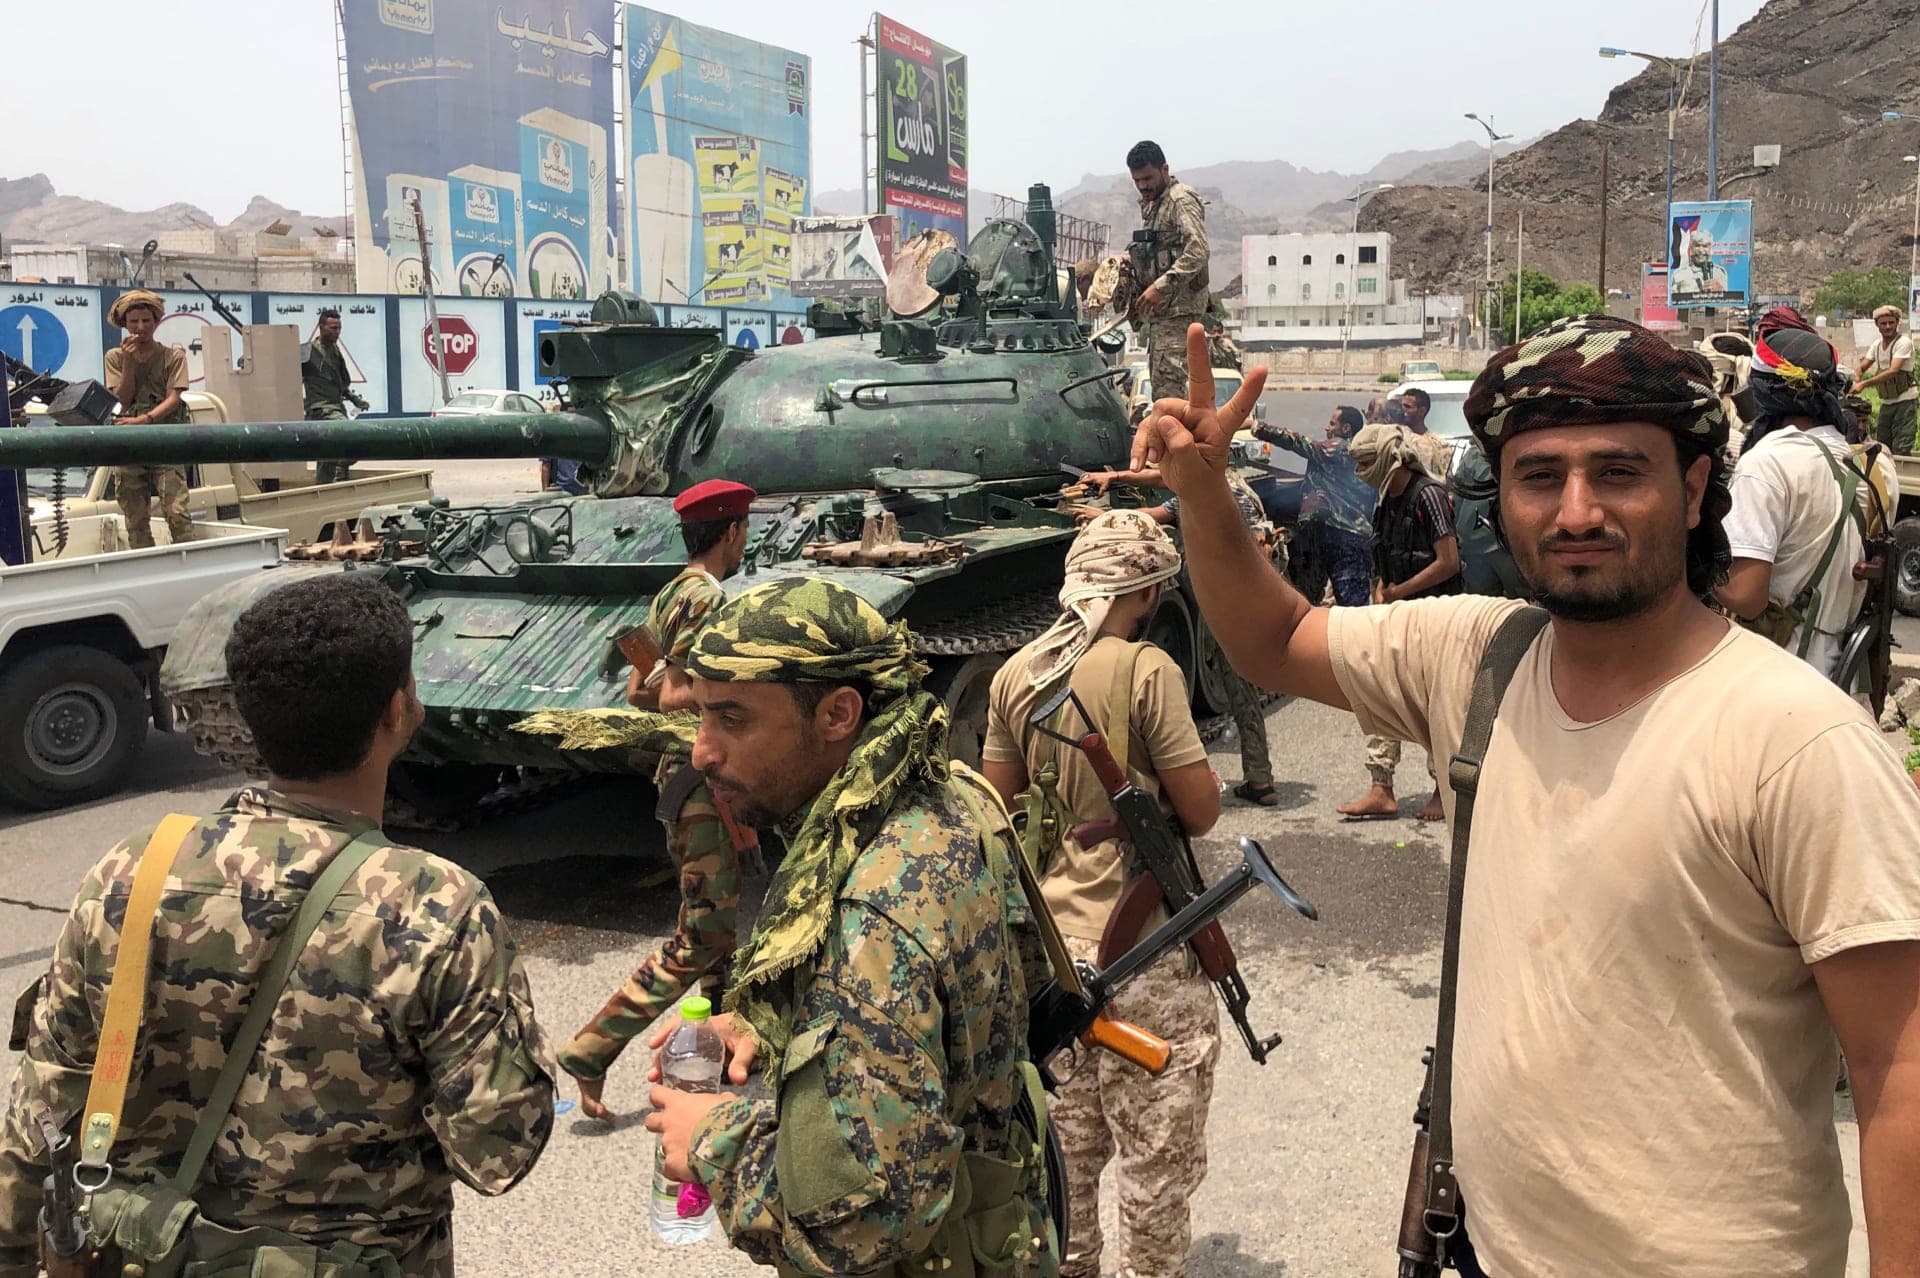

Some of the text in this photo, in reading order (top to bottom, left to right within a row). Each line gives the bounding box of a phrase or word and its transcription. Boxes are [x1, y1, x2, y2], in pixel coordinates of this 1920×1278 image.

[497, 5, 610, 59] حليب
[557, 71, 592, 87] كامل
[895, 58, 918, 100] 28
[897, 101, 935, 156] مارس
[9, 292, 89, 307] علامات المرور
[175, 302, 204, 313] المرور
[349, 304, 376, 314] علامات
[549, 308, 571, 319] المرور
[428, 333, 475, 354] STOP
